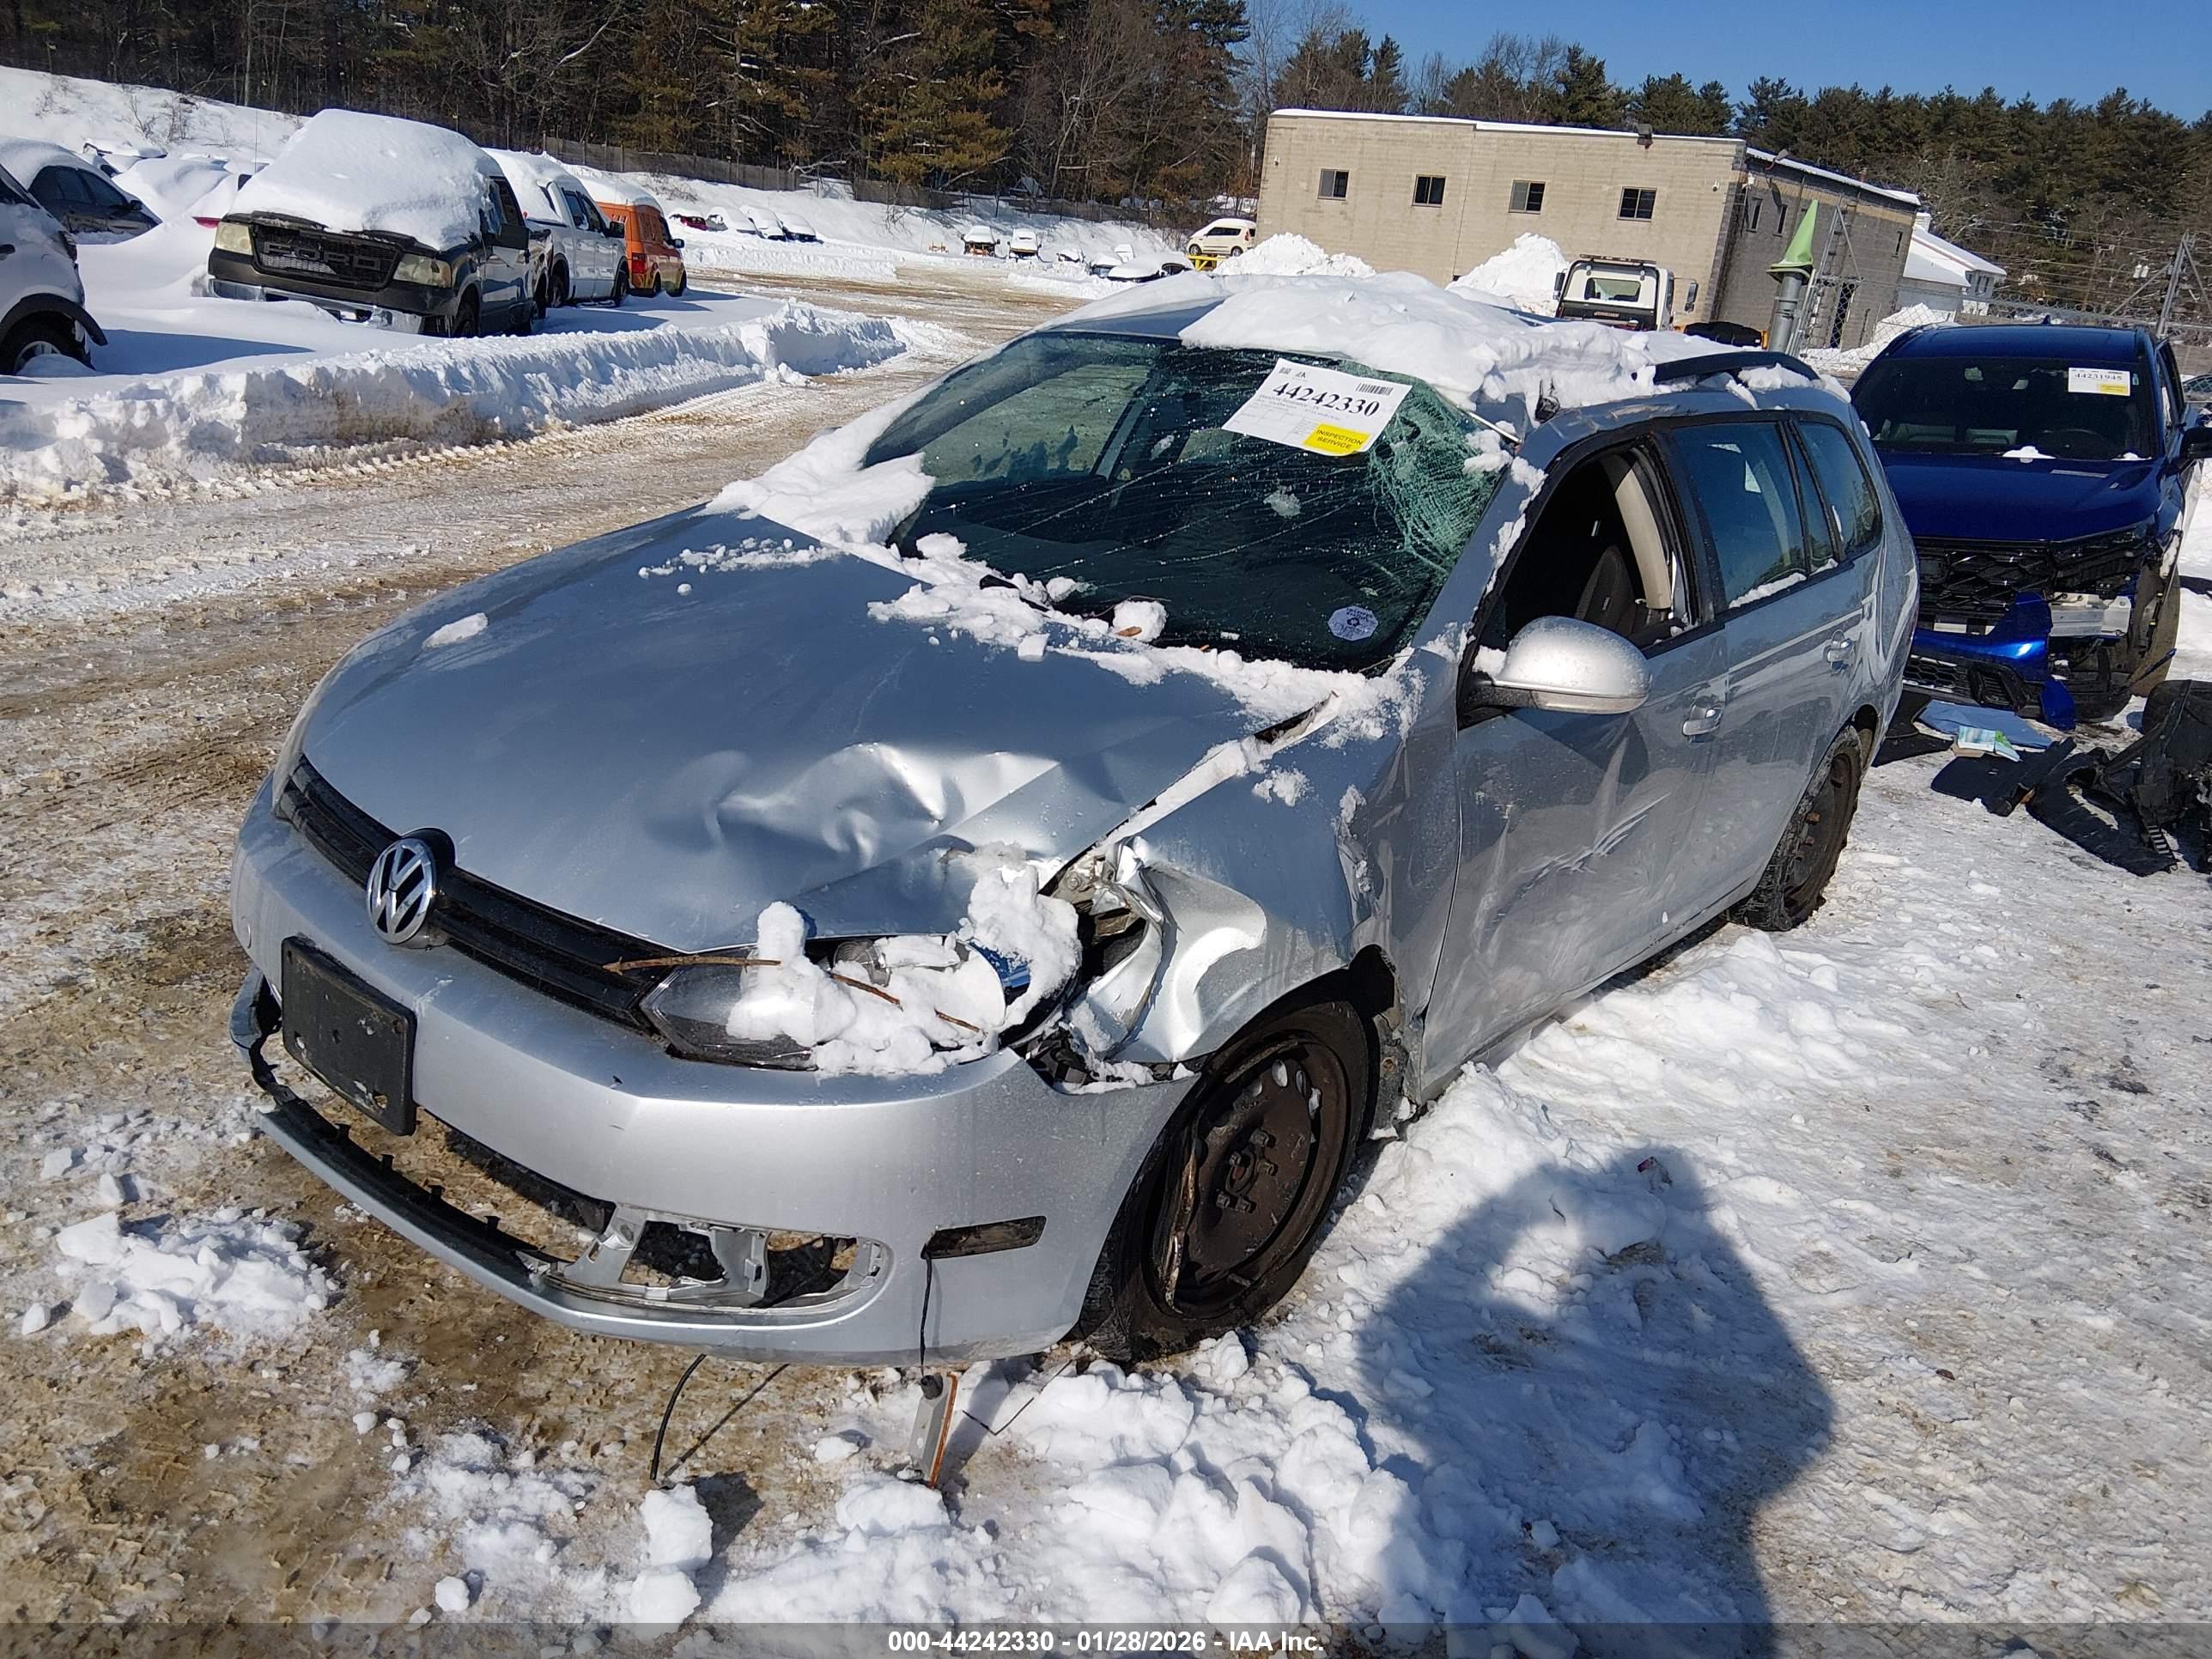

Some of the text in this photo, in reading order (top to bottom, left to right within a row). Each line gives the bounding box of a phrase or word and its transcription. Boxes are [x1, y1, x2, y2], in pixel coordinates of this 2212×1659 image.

[1273, 382, 1380, 417] 44242330
[1316, 429, 1364, 446] INSPECTION
[1316, 436, 1352, 449] SERVICE
